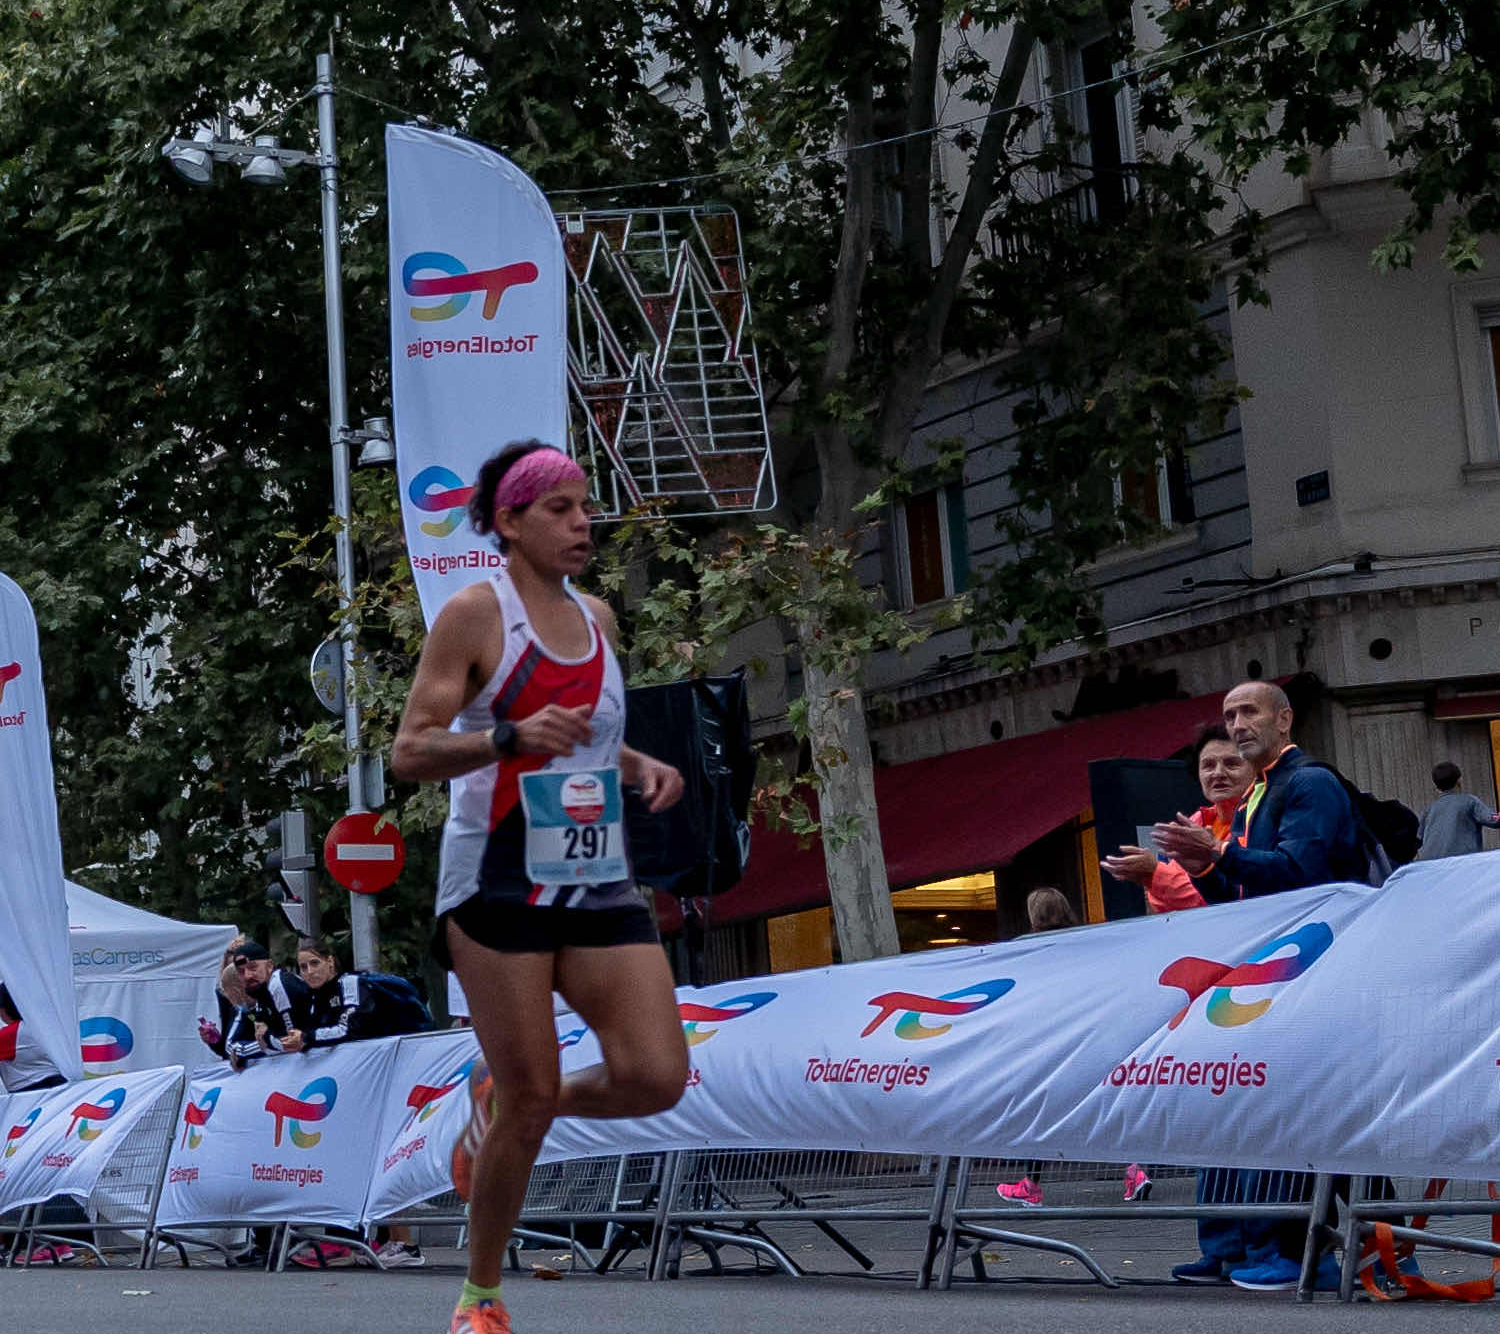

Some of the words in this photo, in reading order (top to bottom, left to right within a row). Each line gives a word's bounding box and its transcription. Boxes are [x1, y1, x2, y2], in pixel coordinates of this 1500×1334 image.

[563, 825, 609, 861] 297
[804, 1057, 931, 1093] TotalEnergies
[250, 1162, 324, 1188] TotalEnergies
